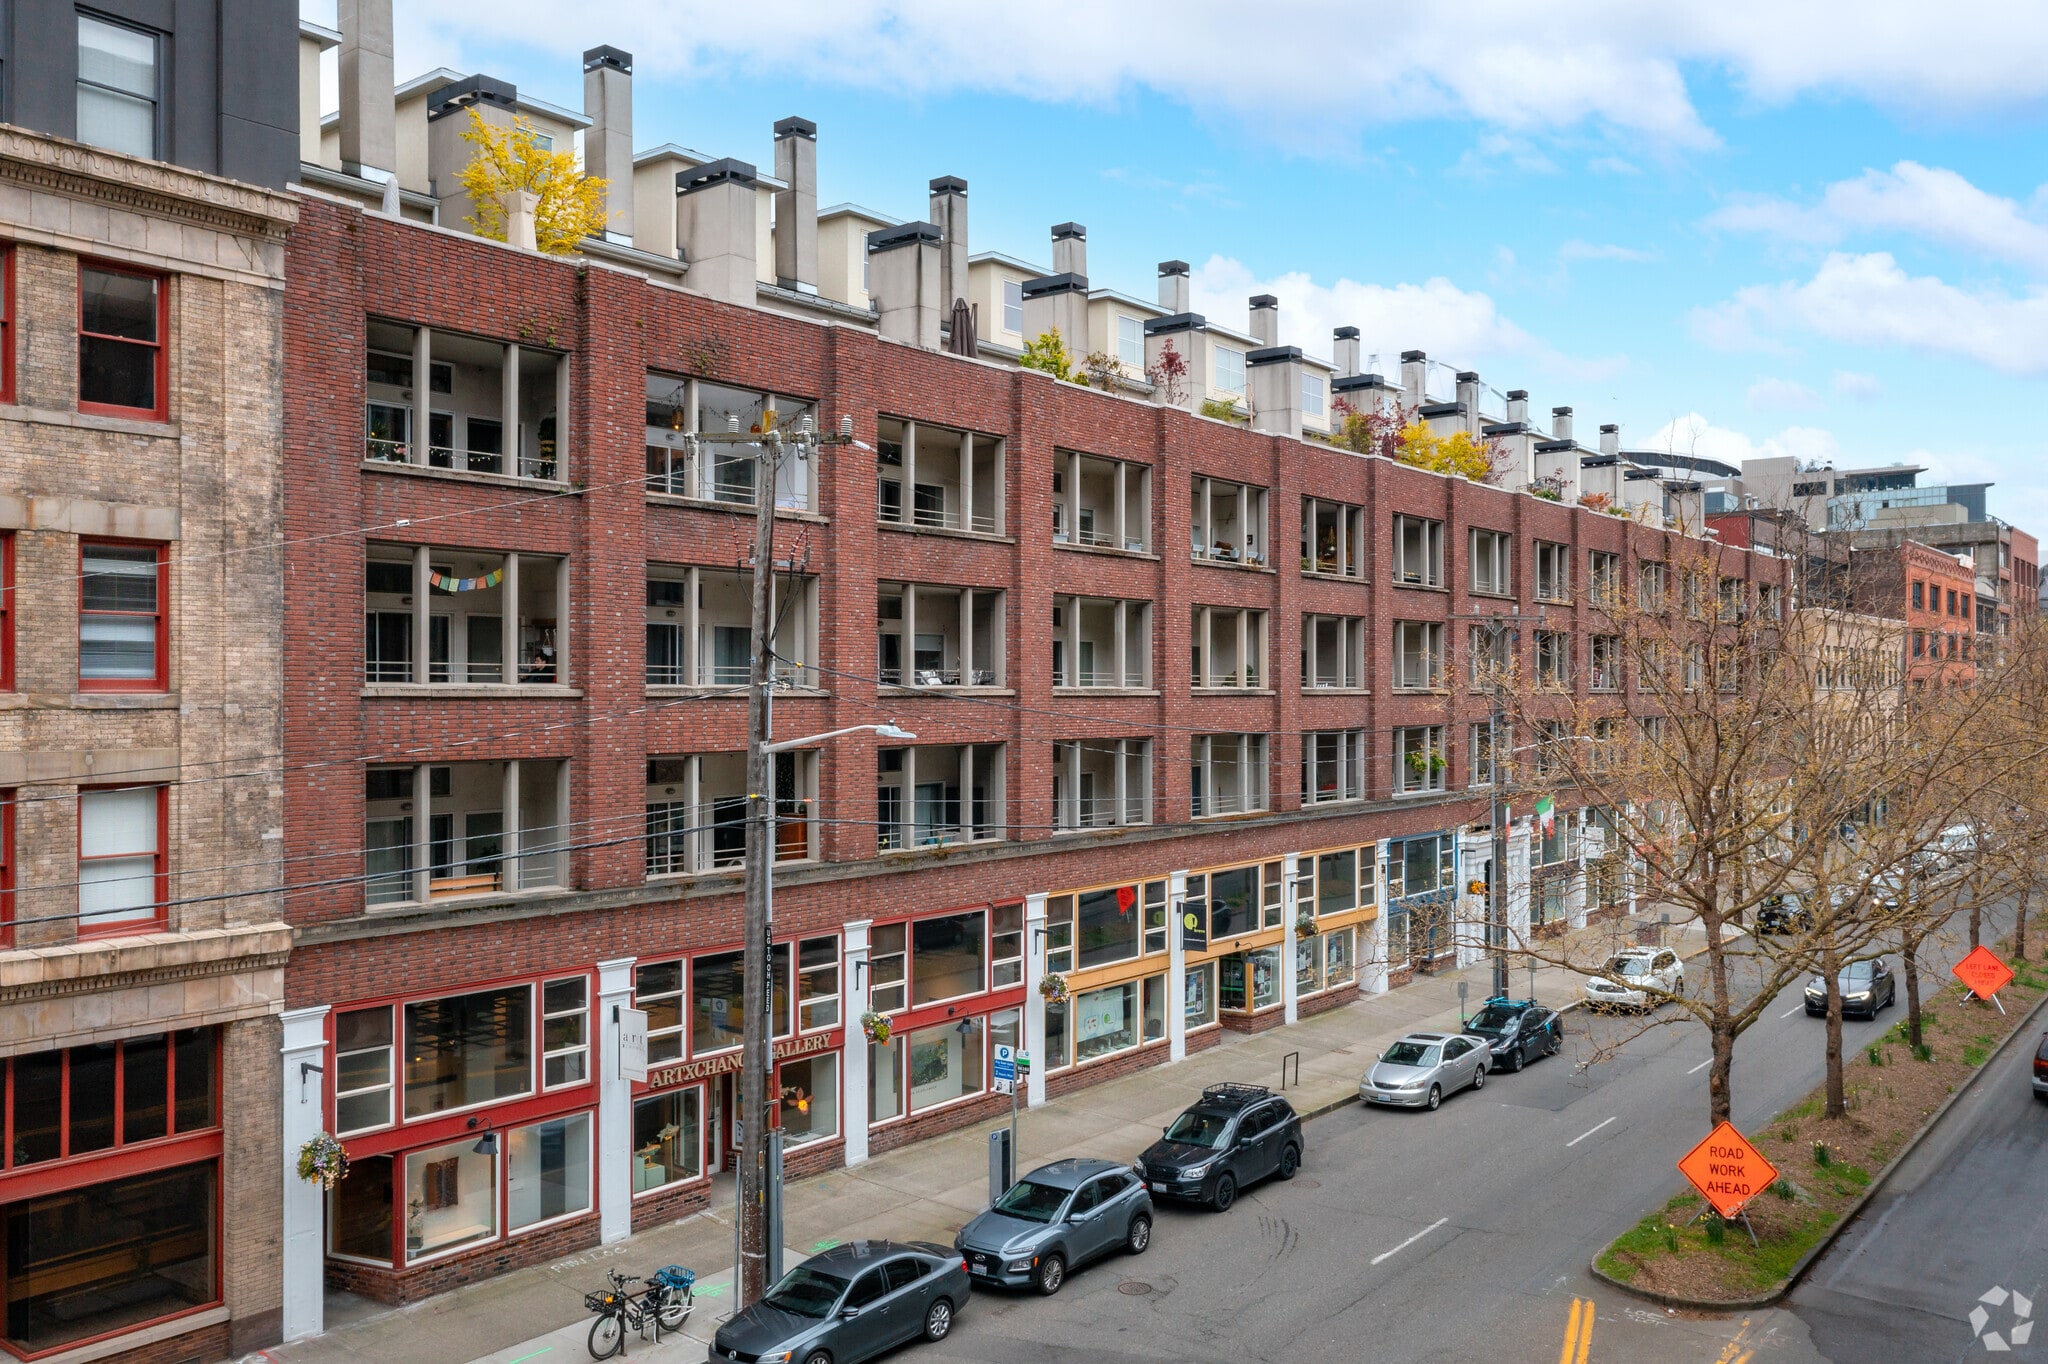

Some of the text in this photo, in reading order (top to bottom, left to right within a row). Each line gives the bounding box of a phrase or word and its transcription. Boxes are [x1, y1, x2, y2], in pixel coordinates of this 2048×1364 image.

[766, 929, 772, 945] UG
[766, 946, 772, 962] TO
[1966, 963, 2000, 972] LEFT LANE
[622, 1033, 642, 1045] art
[650, 1051, 744, 1089] ARTXCHAN
[1709, 1145, 1745, 1160] ROAD
[1709, 1163, 1746, 1178] WORK
[1706, 1181, 1751, 1196] AHEAD
